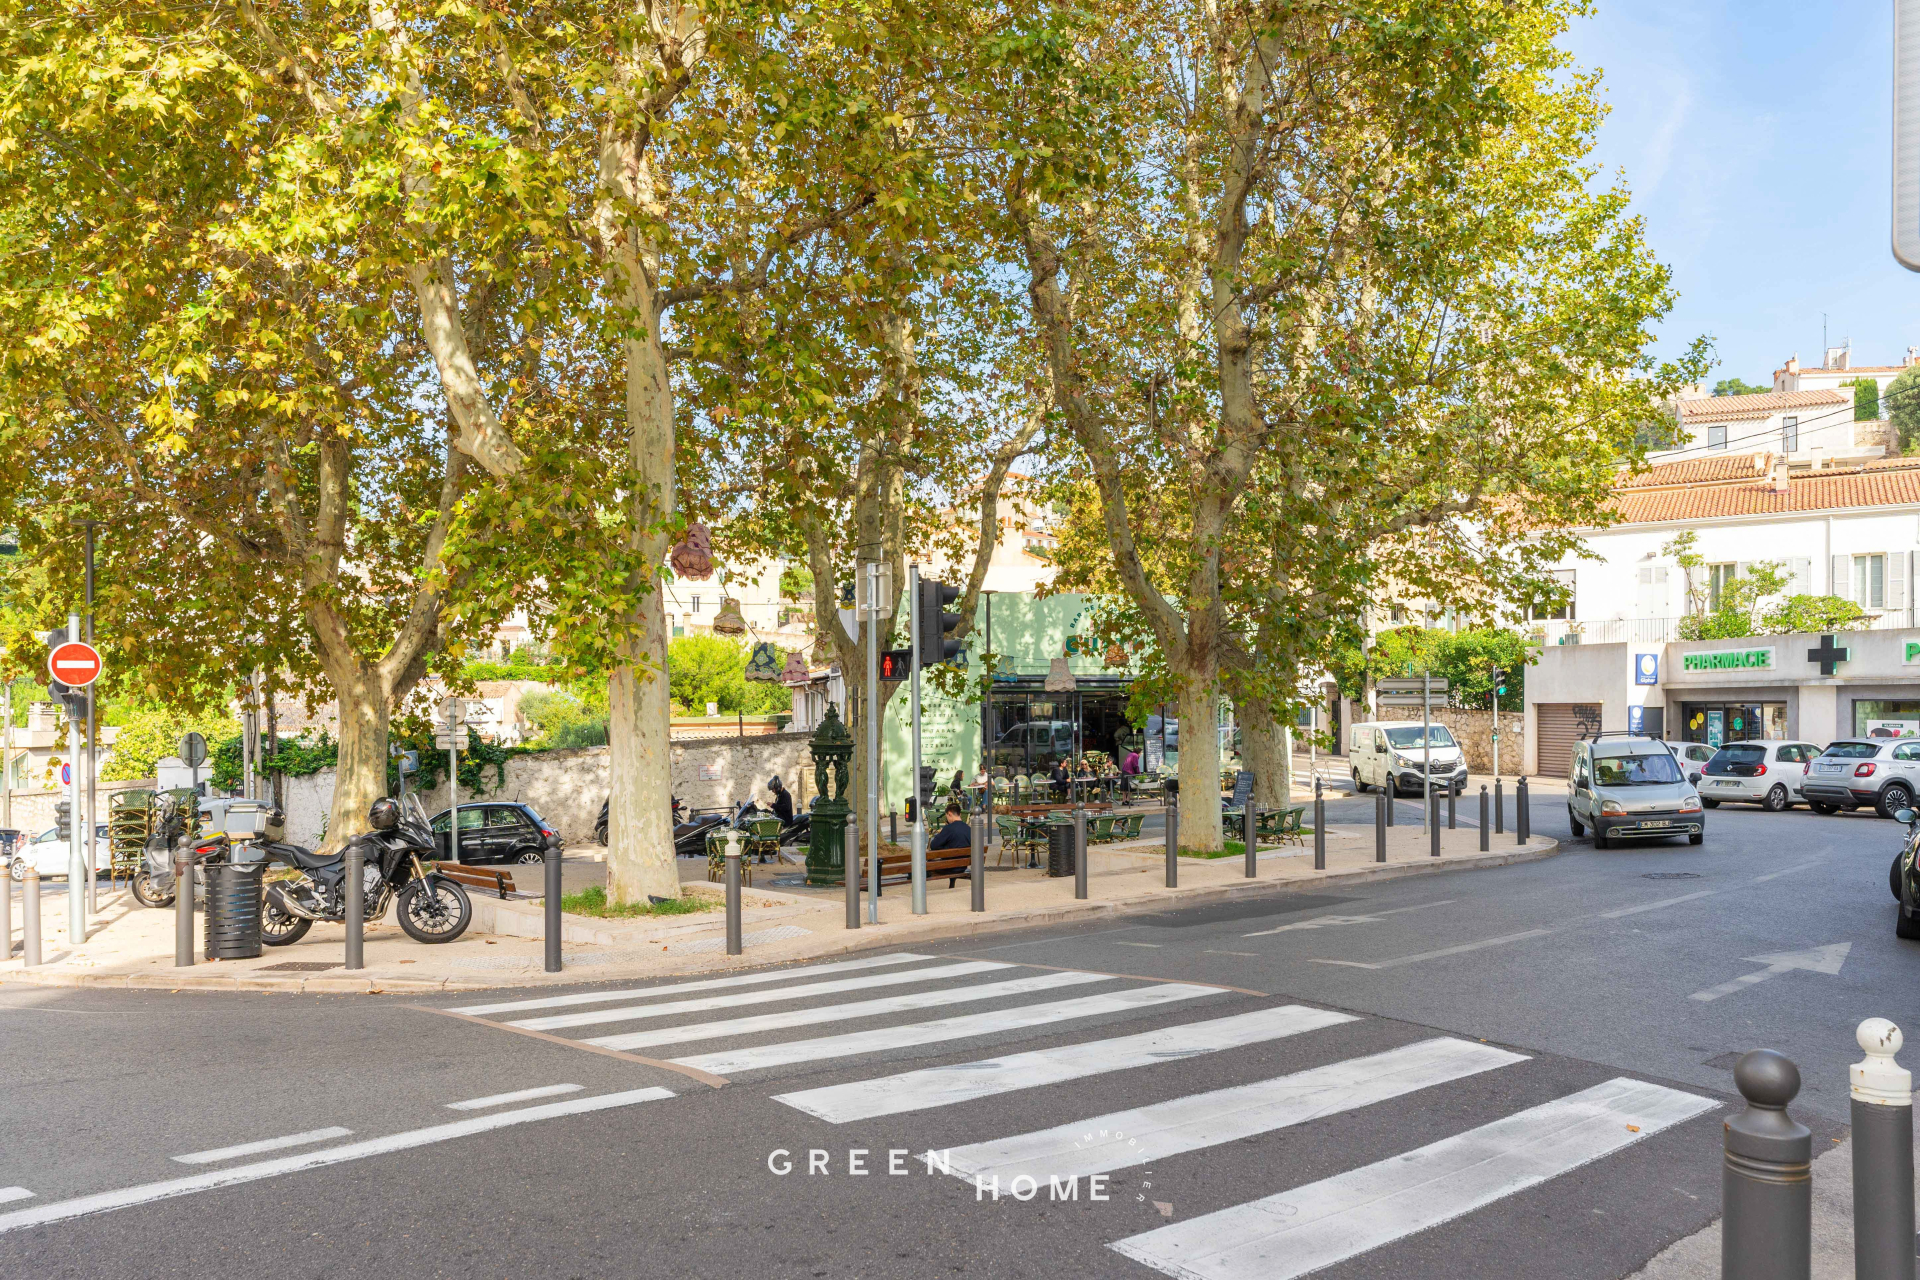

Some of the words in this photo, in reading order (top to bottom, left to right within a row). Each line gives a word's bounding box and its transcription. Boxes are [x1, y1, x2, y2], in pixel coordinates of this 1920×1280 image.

[1070, 612, 1082, 628] BAR
[1084, 605, 1095, 613] DE
[1683, 650, 1771, 670] PHARMACIE
